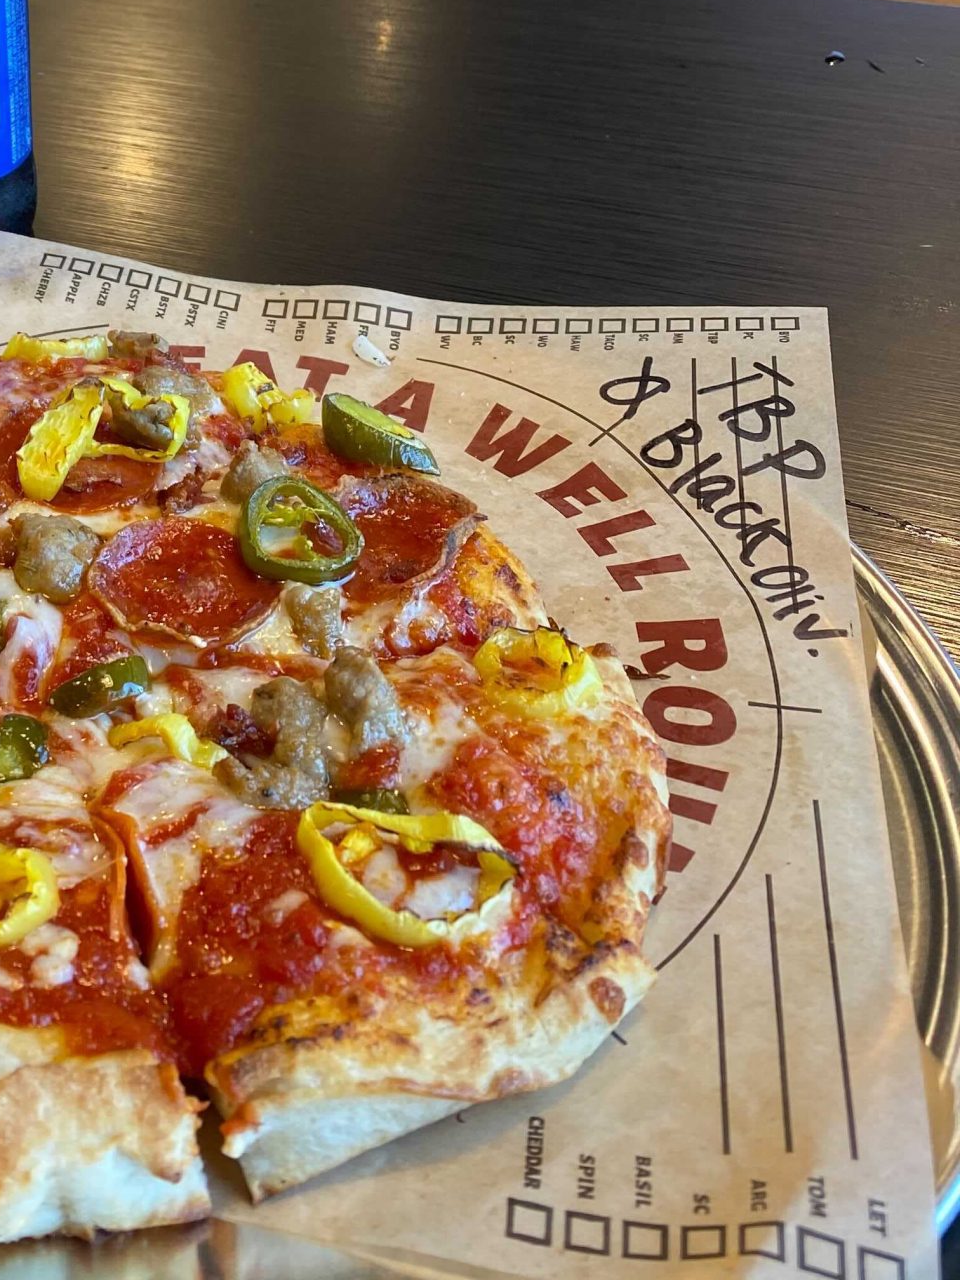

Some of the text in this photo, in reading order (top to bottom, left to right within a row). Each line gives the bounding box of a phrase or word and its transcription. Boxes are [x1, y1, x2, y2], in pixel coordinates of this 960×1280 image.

[34, 268, 54, 304] CHERRY
[65, 273, 82, 304] APPLE
[96, 281, 111, 307] CHZB
[125, 288, 140, 312] CSTX
[155, 296, 169, 319] BSTX
[184, 303, 200, 327] PSTX
[216, 310, 229, 330] CINI
[265, 319, 276, 333] FIT
[294, 320, 306, 342] MED
[325, 321, 338, 345] HAM
[390, 330, 401, 351] BYO
[472, 335, 483, 346] BC
[604, 334, 615, 351] TACO
[673, 332, 684, 344] MM
[779, 331, 790, 343] BYO
[570, 335, 581, 352] HAW
[698, 361, 827, 480] TBP
[374, 378, 435, 433] A
[465, 402, 690, 592] WELL
[523, 1116, 546, 1190] CHEDDAR
[578, 1153, 596, 1200] SPIN
[634, 1154, 652, 1209] BASIL
[692, 1193, 711, 1216] SC
[749, 1179, 768, 1213] ARG
[806, 1175, 825, 1219] TOM
[867, 1197, 887, 1239] LET
